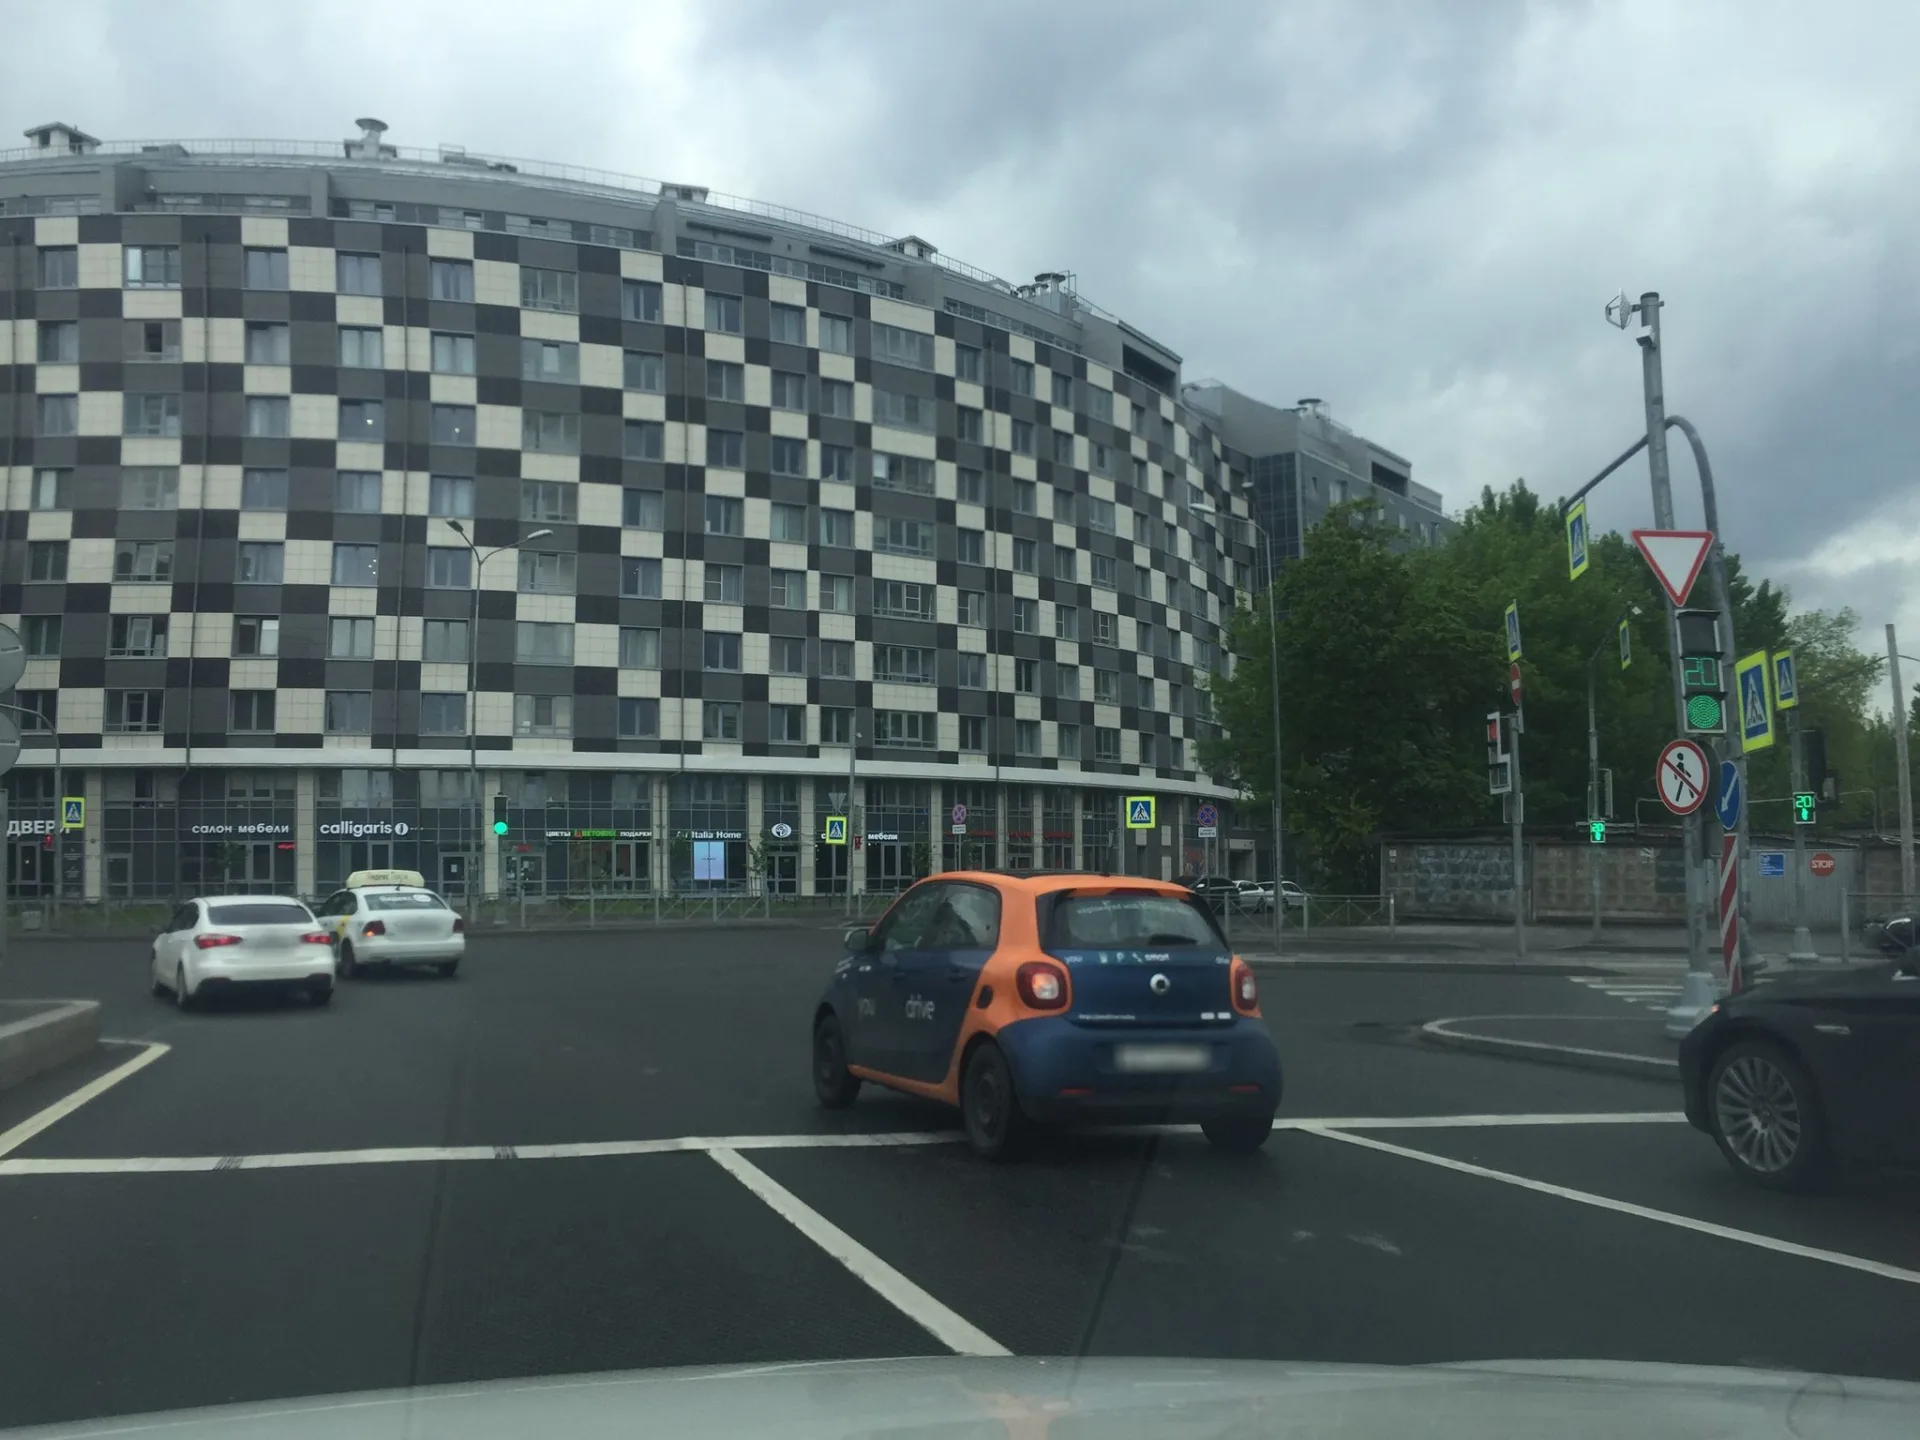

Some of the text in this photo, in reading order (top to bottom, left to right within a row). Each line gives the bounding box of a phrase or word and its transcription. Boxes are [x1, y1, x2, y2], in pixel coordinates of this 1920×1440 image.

[1684, 656, 1718, 687] 20
[1795, 795, 1812, 808] 20
[191, 822, 290, 834] салон мебели
[319, 820, 393, 838] calligaris
[545, 830, 572, 838] ЦВЕТЫ
[619, 830, 653, 838] ПОДАРКИ
[691, 831, 714, 839] Italia
[716, 831, 742, 839] Home
[867, 832, 898, 840] мебели
[1811, 859, 1835, 869] STOP
